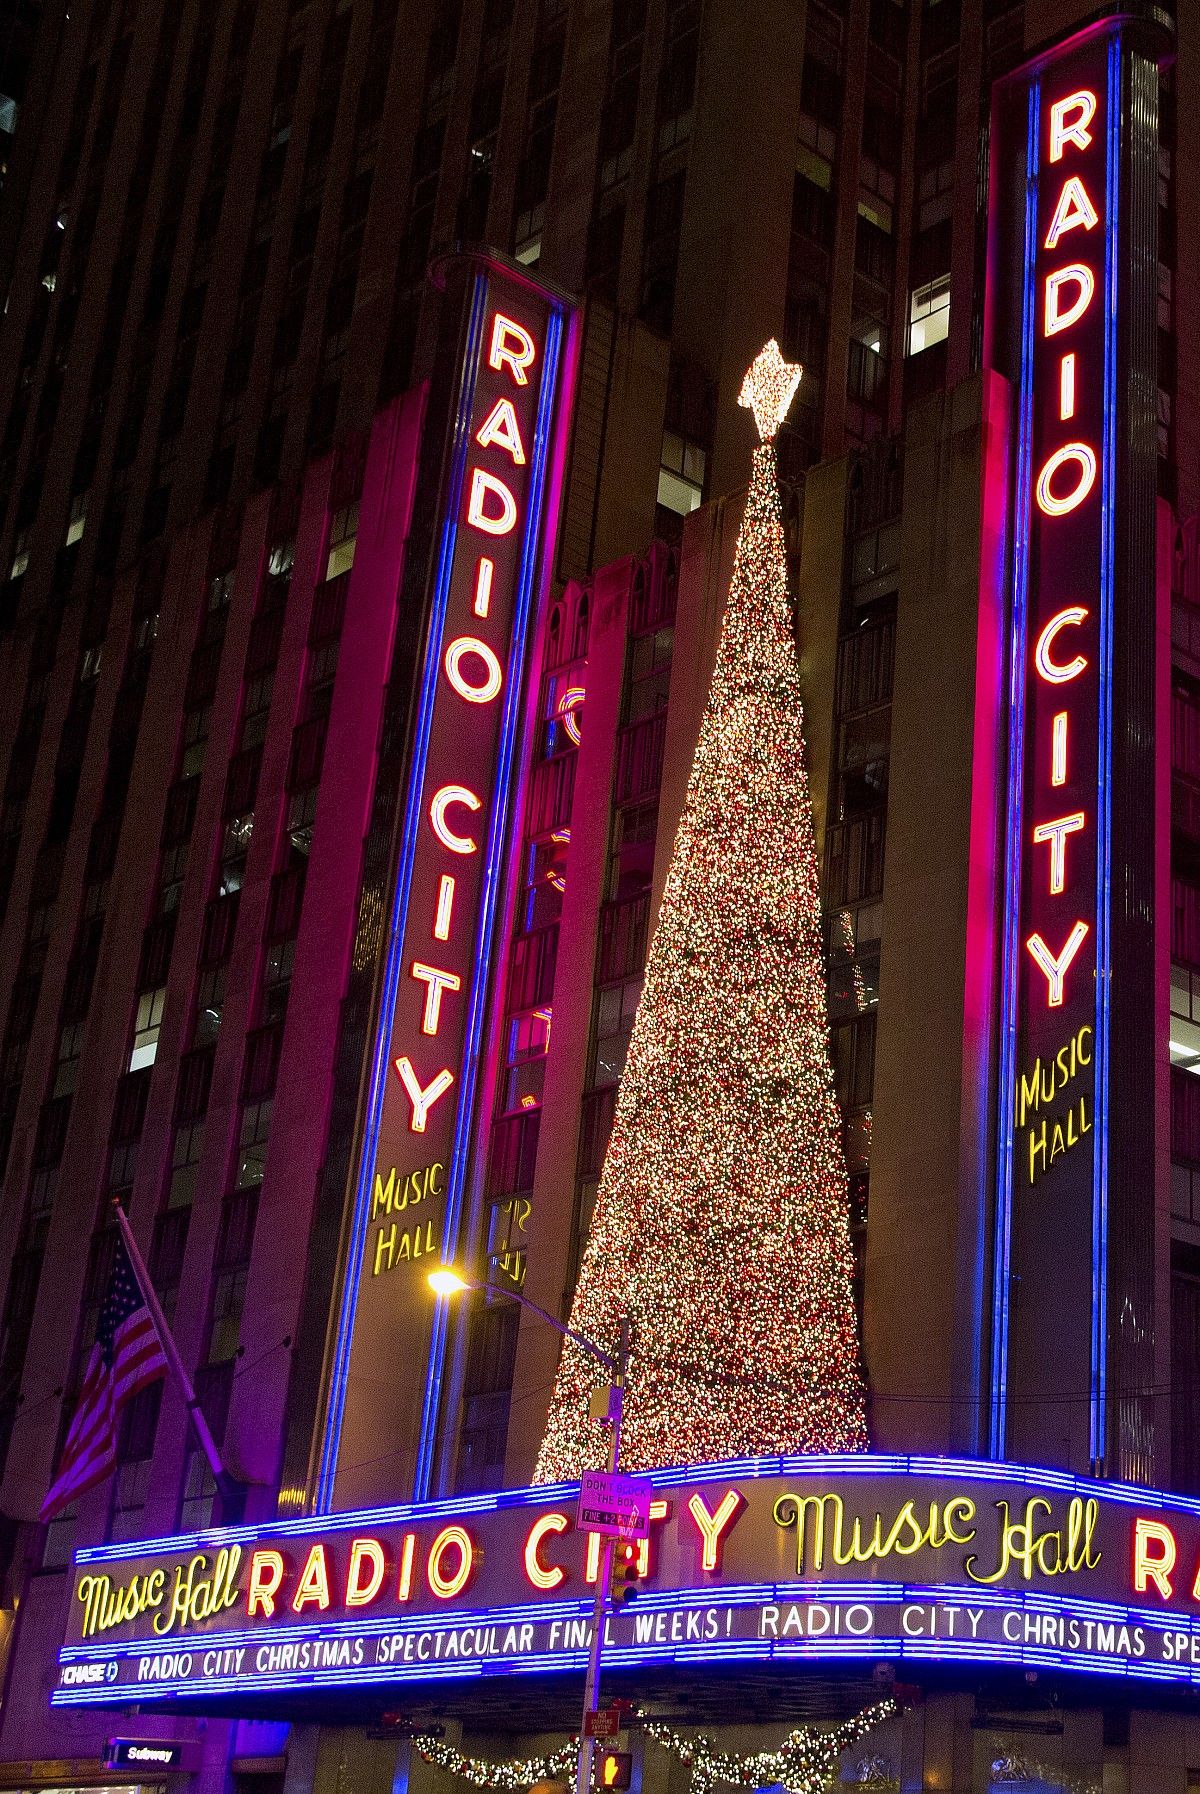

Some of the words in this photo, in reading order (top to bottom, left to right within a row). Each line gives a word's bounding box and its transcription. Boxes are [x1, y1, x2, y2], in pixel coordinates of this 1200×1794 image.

[1036, 90, 1098, 516] RADIO
[445, 313, 535, 703] RADIO
[1027, 606, 1089, 1007] CITY
[395, 785, 481, 1133] CITY
[584, 1510, 601, 1521] FINE
[586, 1480, 613, 1492] DON'T
[598, 1494, 614, 1505] THE
[617, 1497, 634, 1507] BOX
[247, 1525, 474, 1618] RADIO
[773, 1492, 976, 1575] Music
[965, 1496, 1101, 1584] Hall
[78, 1569, 164, 1637] Music
[154, 1543, 244, 1635] Hall
[64, 1663, 106, 1684] CHASE
[138, 1653, 192, 1681] RADIO
[203, 1649, 246, 1676] CITY
[256, 1637, 364, 1675] CHRISTMAS
[378, 1624, 533, 1663] SPECTACULAR
[635, 1611, 732, 1643] WEEKS!
[761, 1605, 873, 1636] RADIO
[903, 1606, 984, 1637] CITY
[1003, 1612, 1145, 1656] CHRISTMAS
[127, 1747, 173, 1763] Subway
